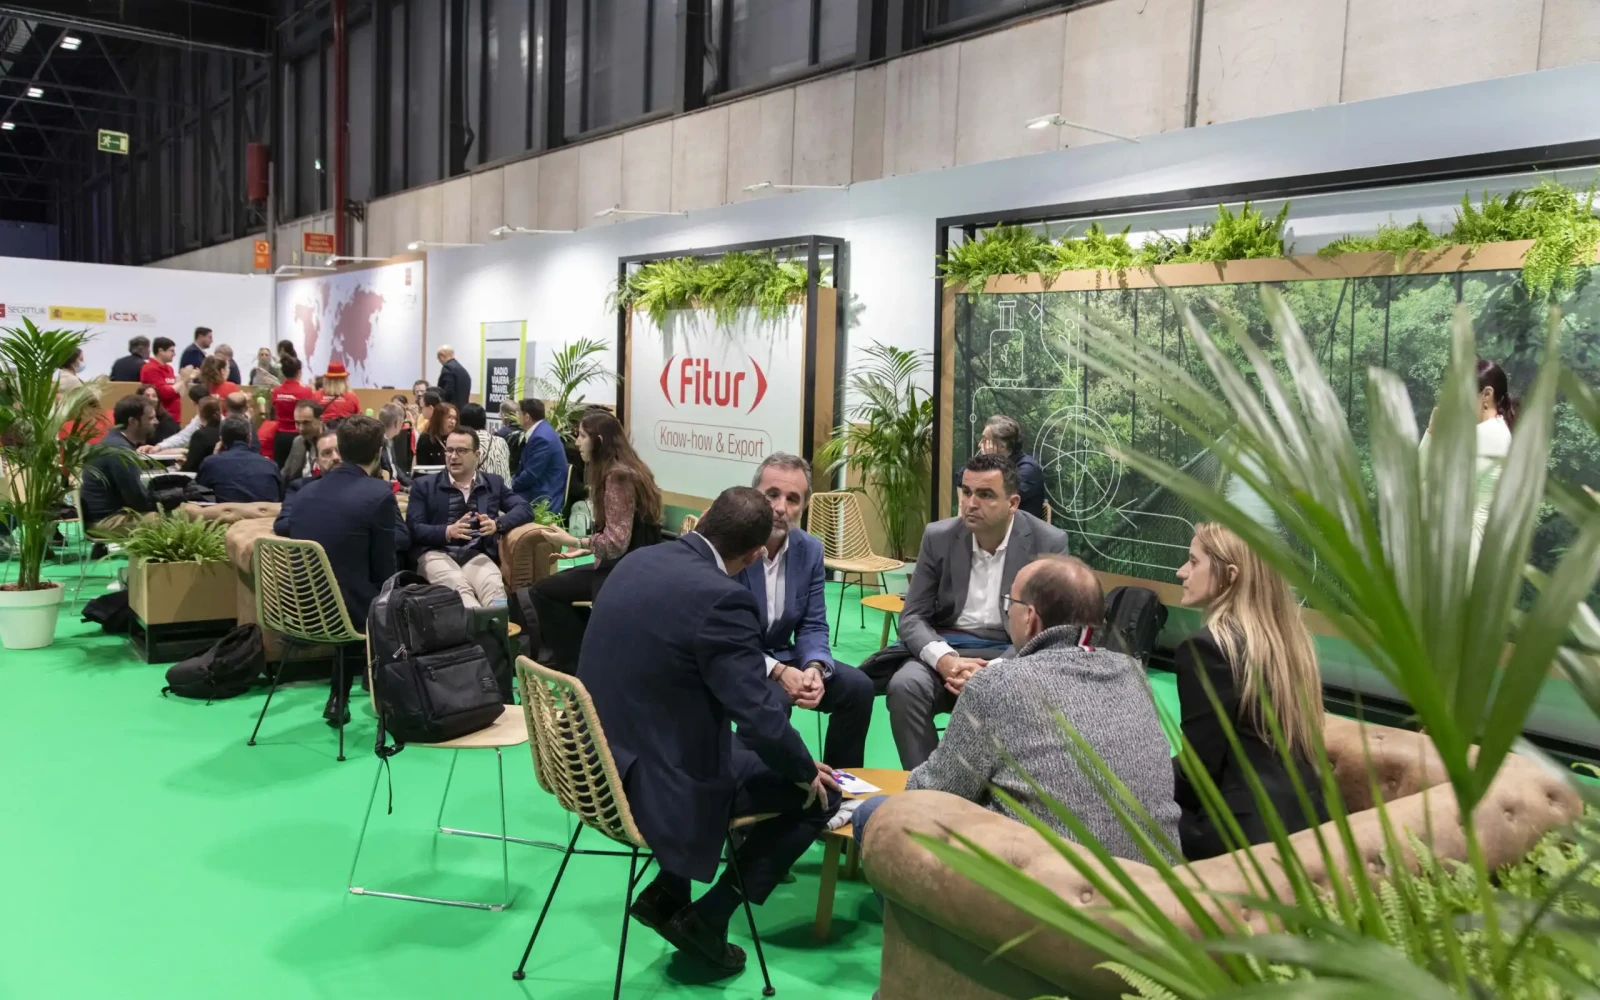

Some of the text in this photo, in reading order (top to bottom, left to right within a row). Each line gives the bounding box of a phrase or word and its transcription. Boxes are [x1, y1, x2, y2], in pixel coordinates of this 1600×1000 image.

[494, 367, 508, 376] RADIO
[491, 375, 509, 384] VIAJERA
[680, 358, 746, 408] Fitur
[492, 384, 508, 393] TRAVEL
[660, 426, 764, 460] Know-how & Export
